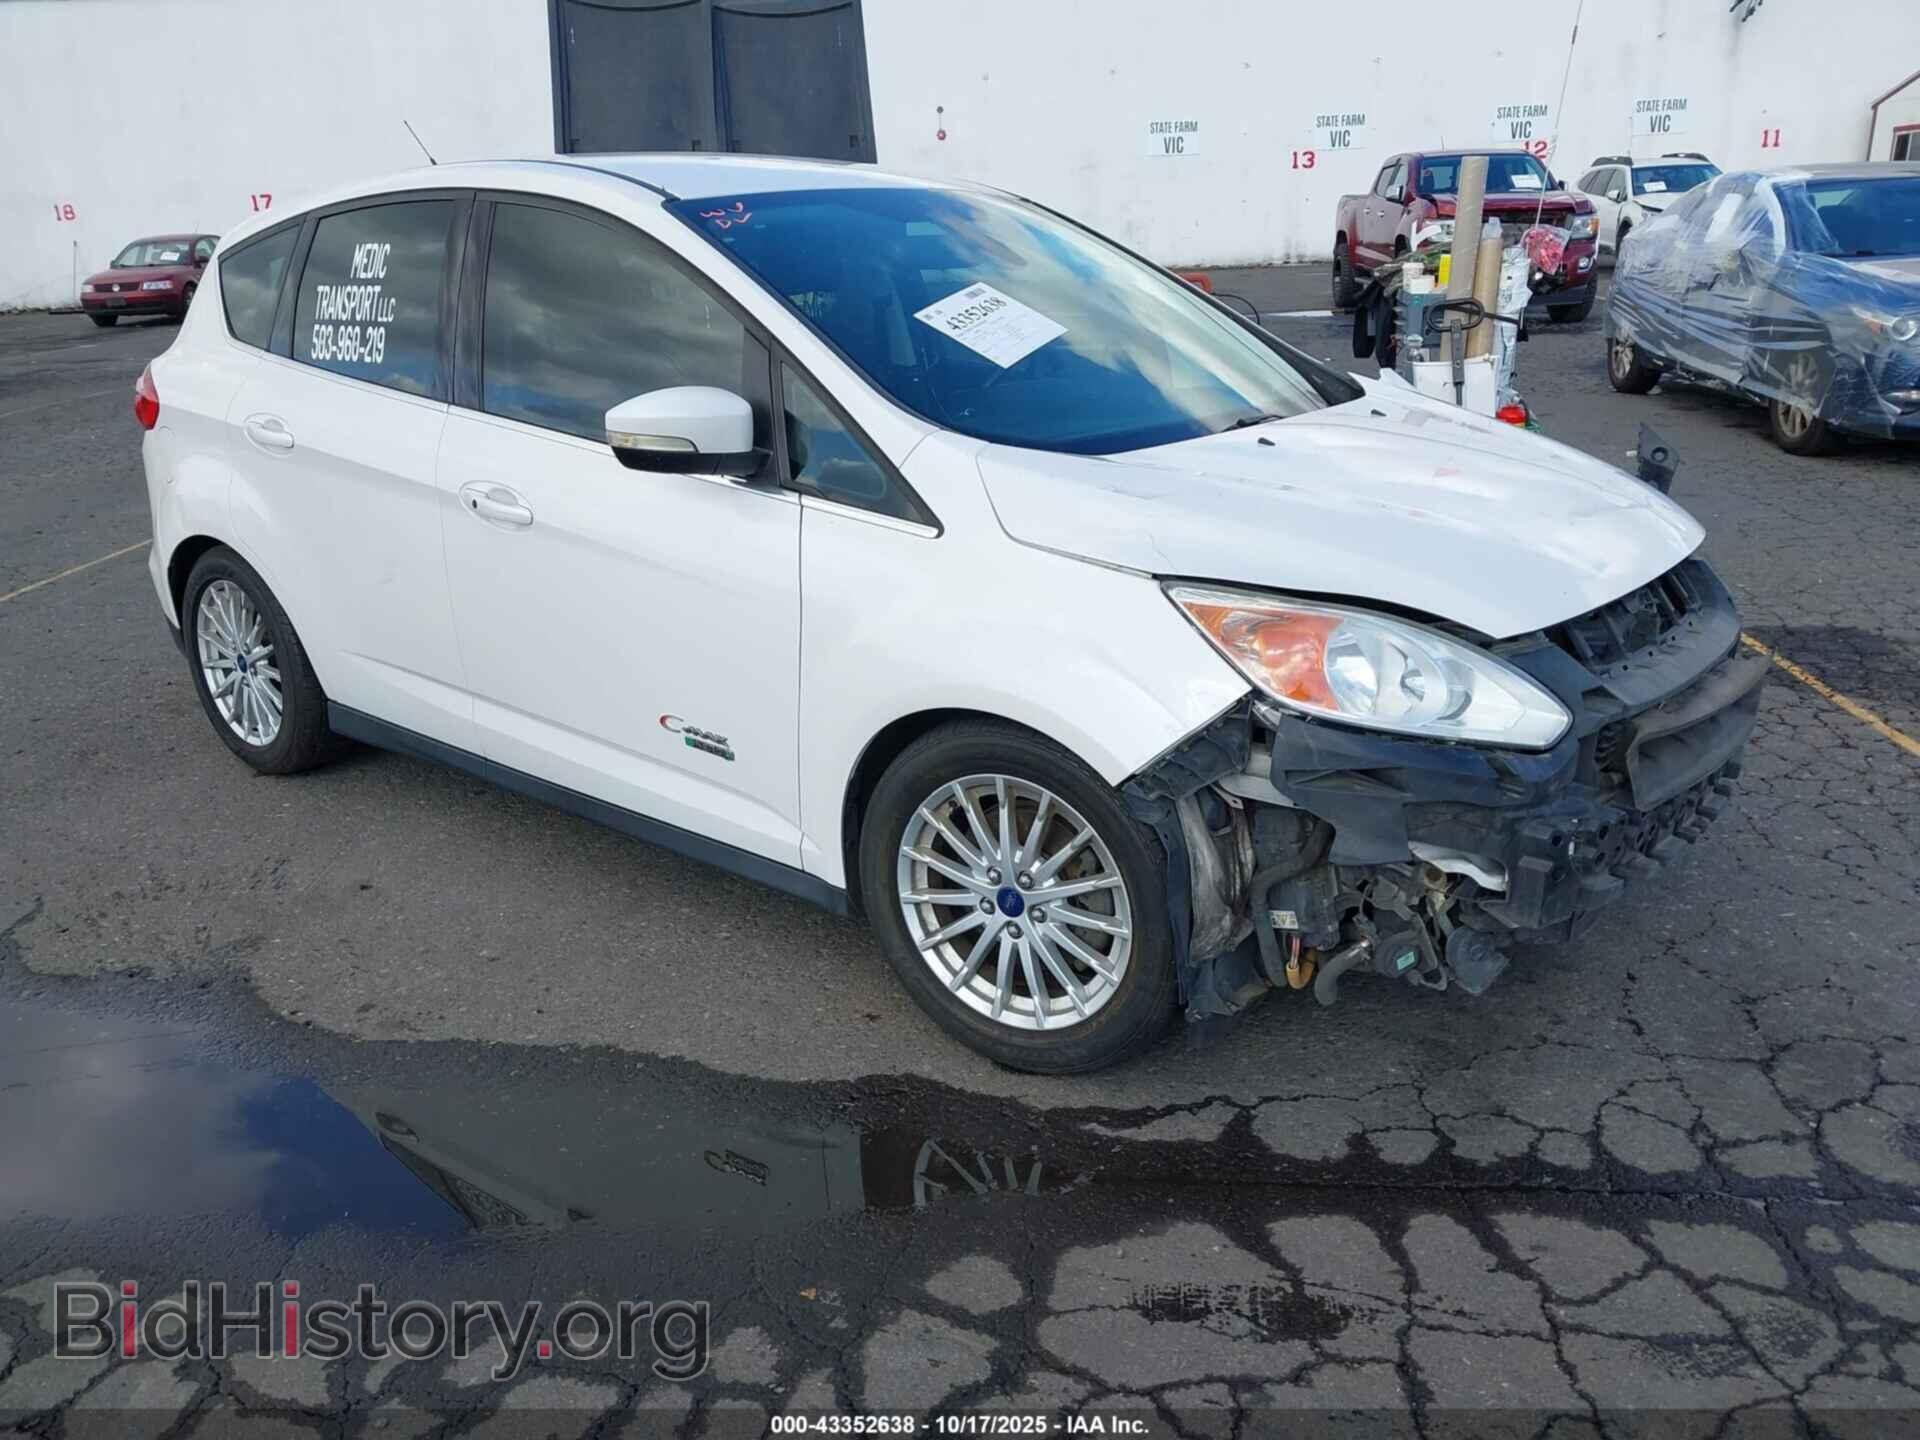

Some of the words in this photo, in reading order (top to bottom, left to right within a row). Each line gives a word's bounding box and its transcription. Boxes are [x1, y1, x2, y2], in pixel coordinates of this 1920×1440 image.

[1496, 106, 1520, 119] STATE
[1522, 104, 1547, 118] FARM
[1636, 100, 1661, 112] STATE
[1662, 98, 1687, 111] FARM
[1150, 121, 1172, 134] STATE
[1174, 121, 1198, 133] FARM
[1316, 115, 1339, 128] STATE
[1341, 113, 1365, 127] FARM
[1511, 120, 1532, 139] VIC
[1650, 114, 1671, 132] VIC
[1163, 136, 1184, 153] VIC
[1330, 129, 1351, 148] VIC
[1760, 129, 1781, 148] 11
[1292, 150, 1316, 169] 13
[53, 203, 77, 222] 18
[251, 194, 273, 212] 17
[350, 242, 391, 279] MEDIC
[315, 284, 382, 322] TRANSPORT
[376, 297, 397, 322] LLC
[946, 297, 1008, 331] 43352638
